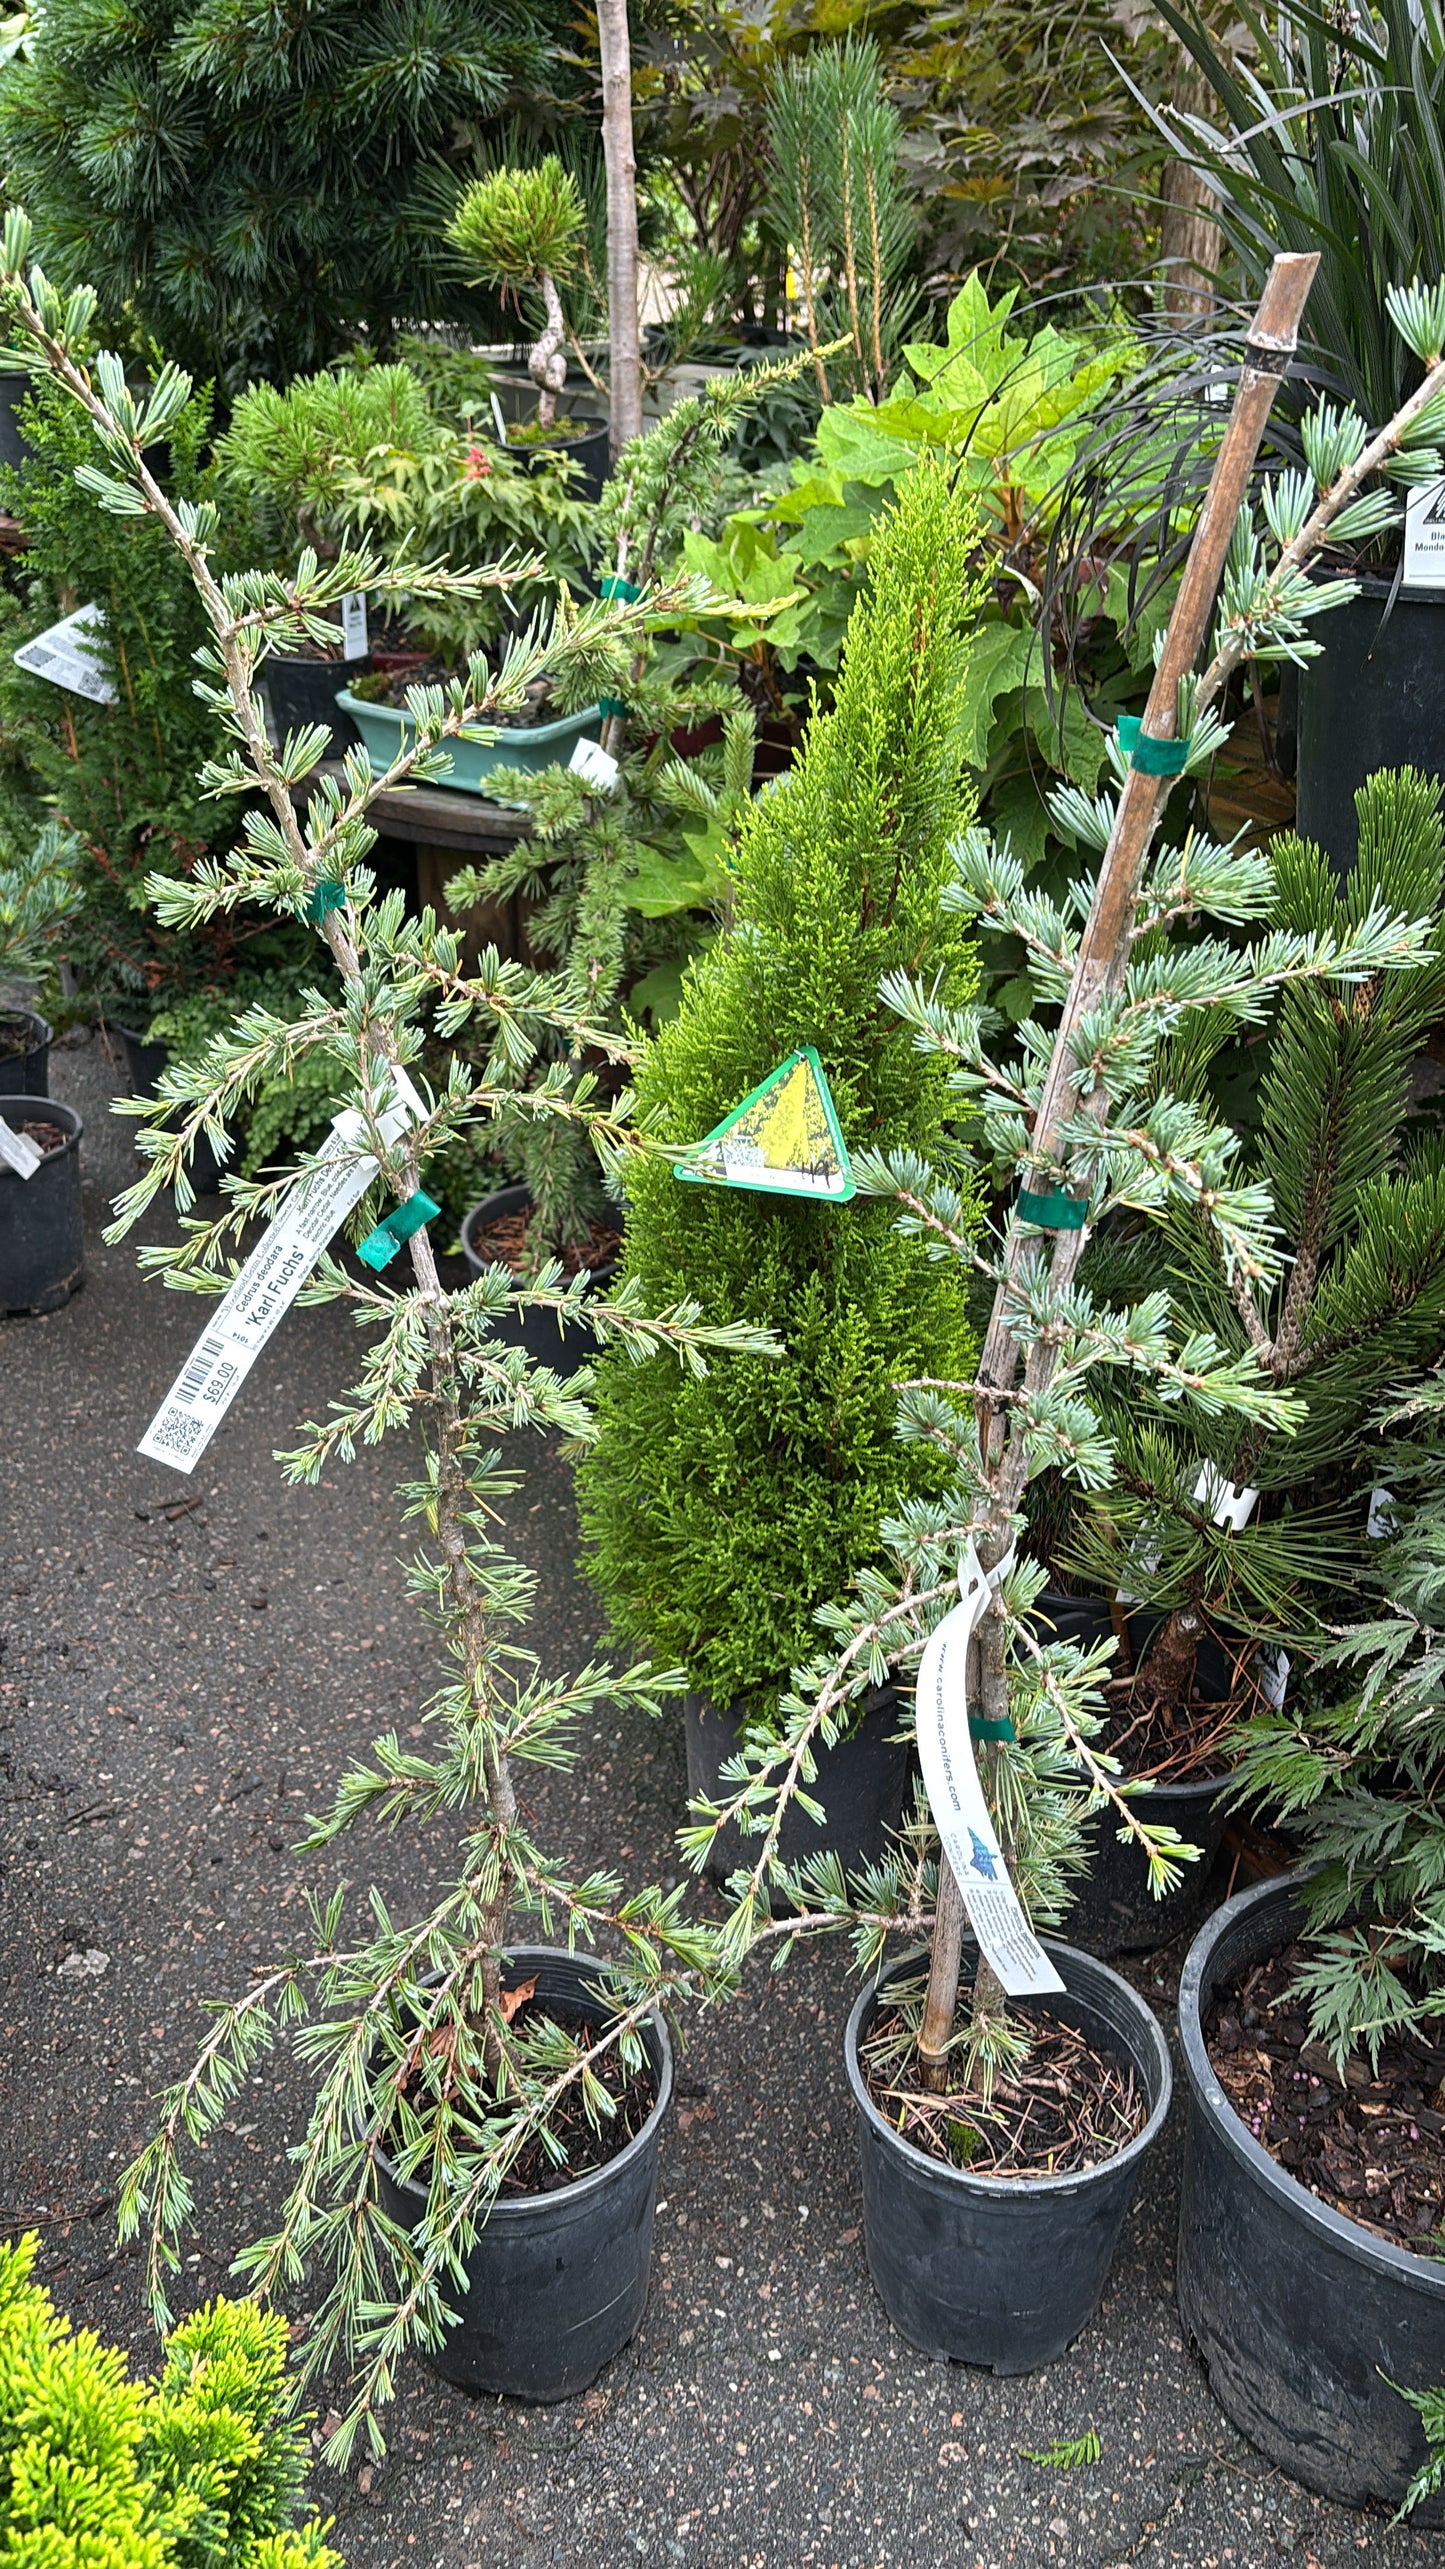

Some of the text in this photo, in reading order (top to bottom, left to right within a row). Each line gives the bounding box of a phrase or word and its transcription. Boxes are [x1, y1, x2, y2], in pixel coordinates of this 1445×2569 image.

[1415, 542, 1444, 552] Mondo
[235, 1279, 260, 1313] Cedrus
[254, 1243, 283, 1281] deodara
[245, 1292, 276, 1327] 'Karl
[268, 1243, 304, 1295] Fuchs'
[202, 1360, 234, 1403] $69.00
[935, 1641, 962, 1811] www.carolinaconifers.com
